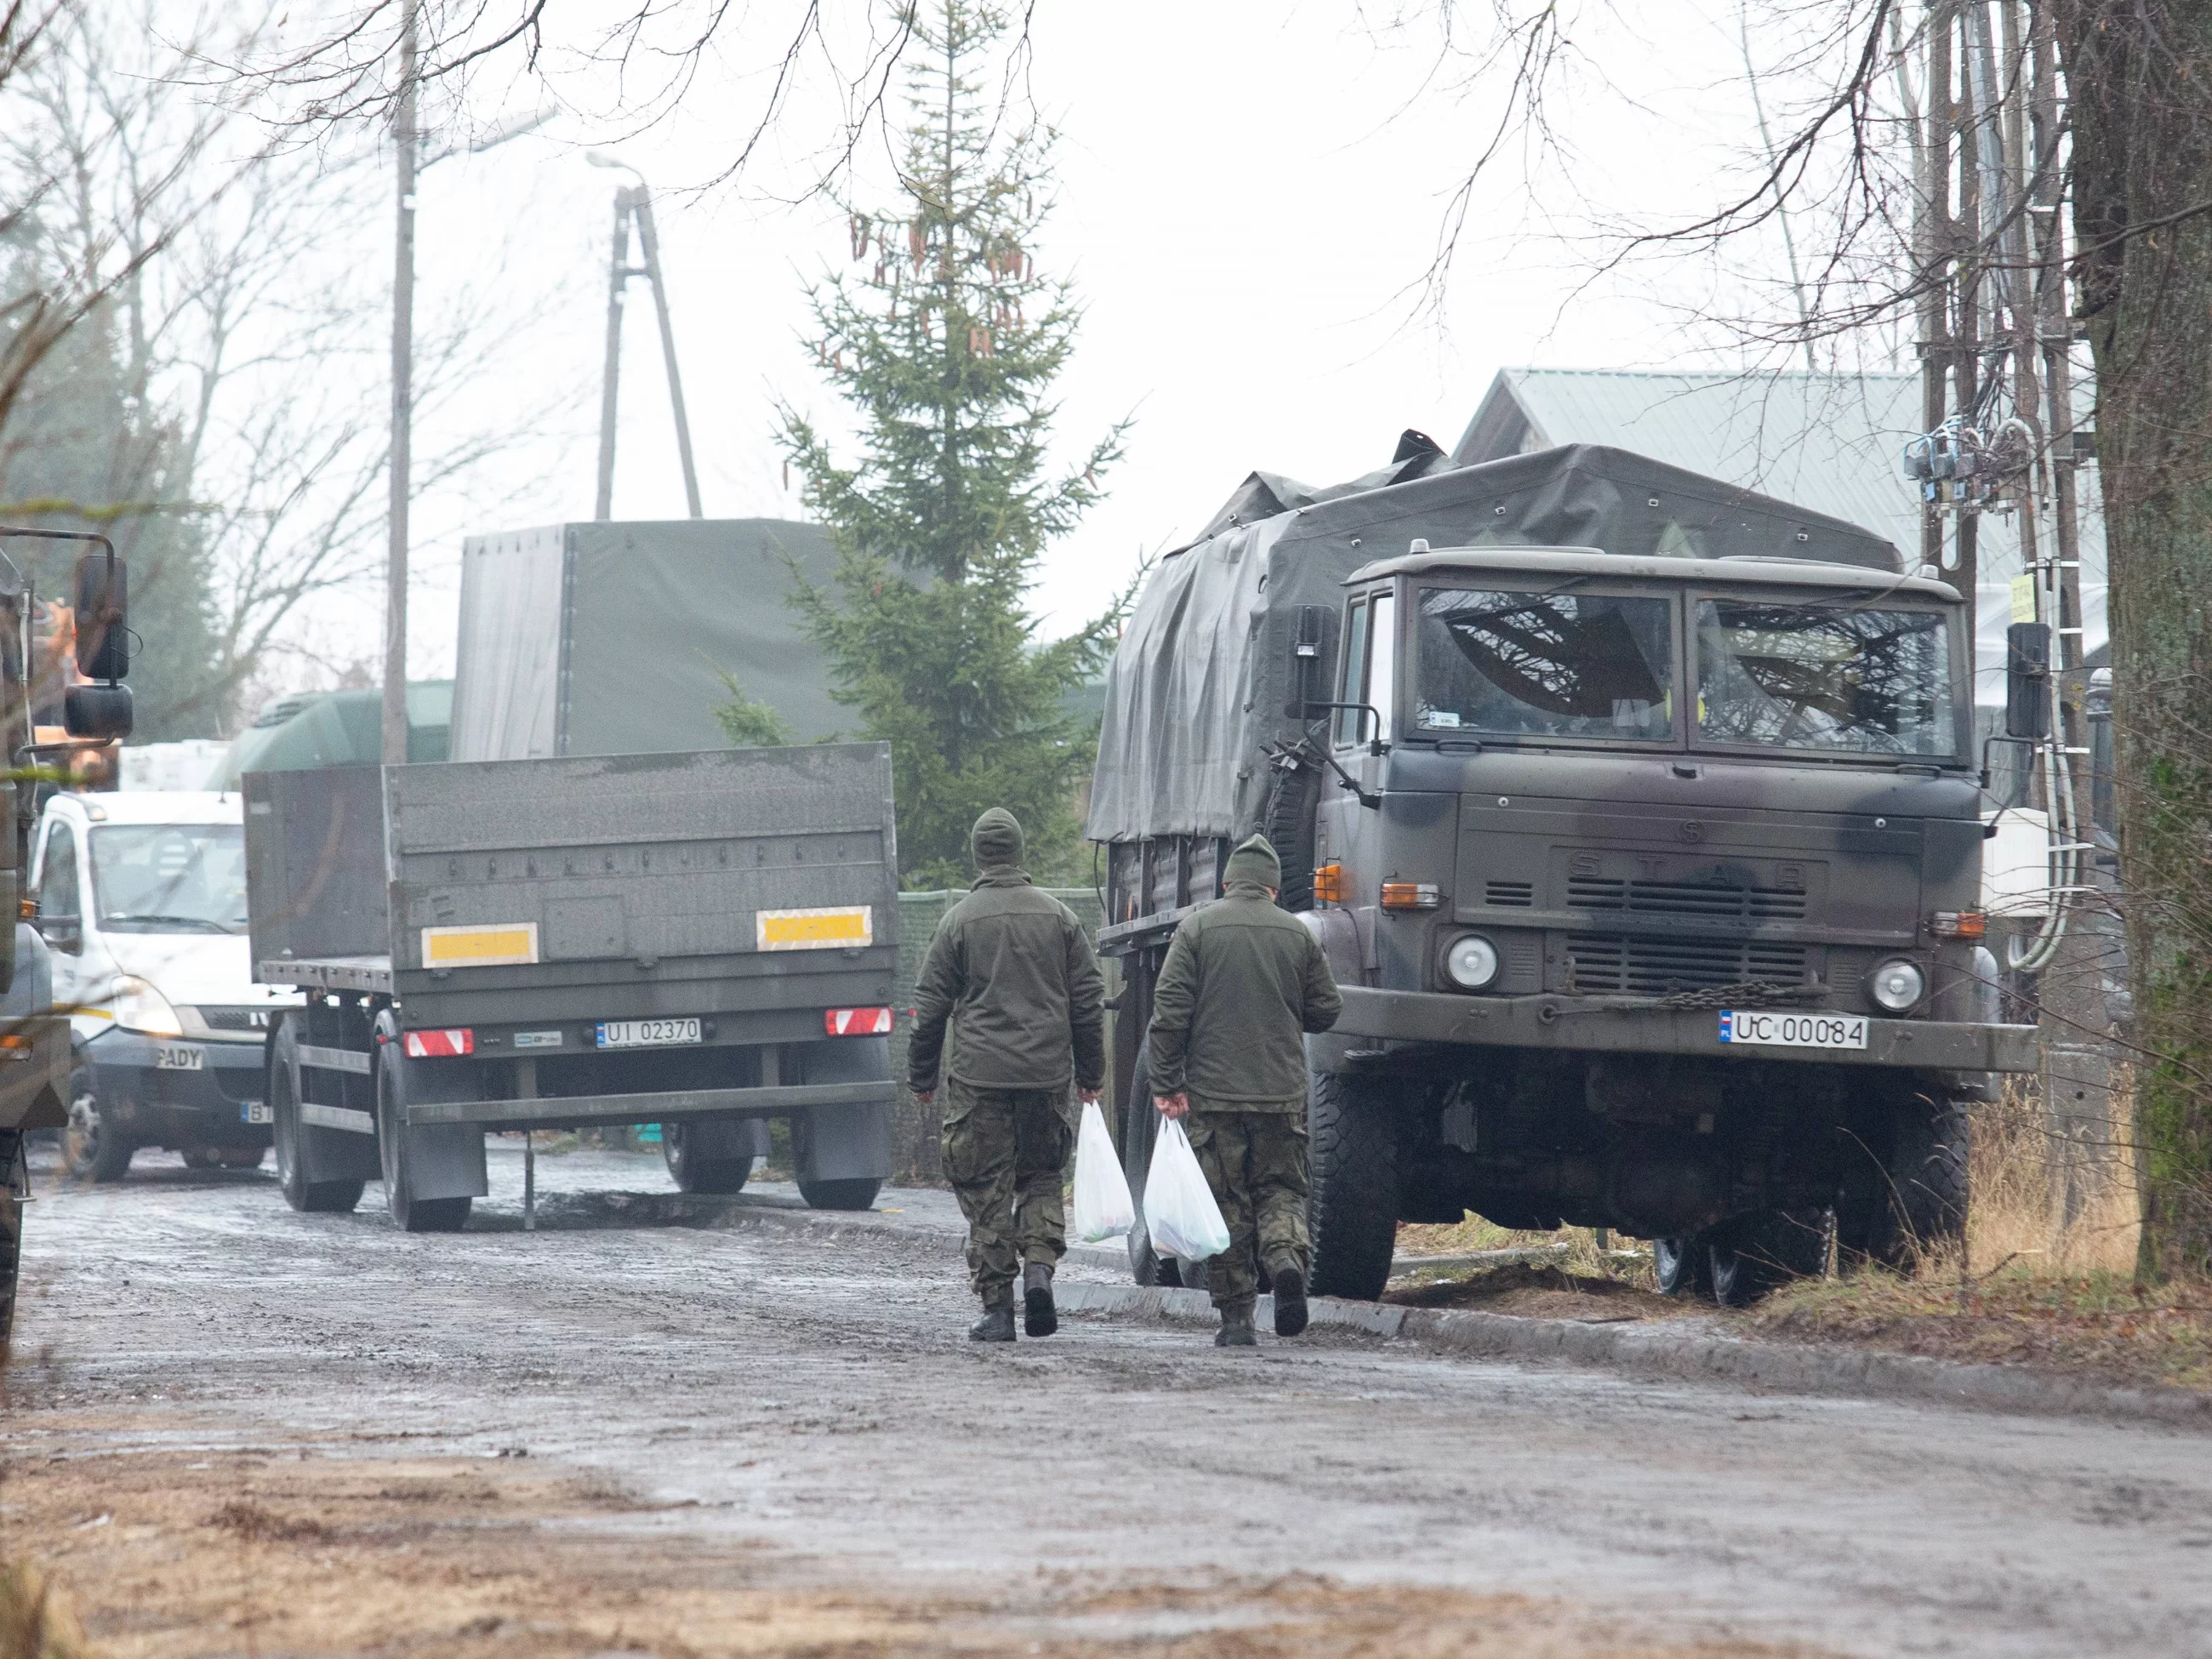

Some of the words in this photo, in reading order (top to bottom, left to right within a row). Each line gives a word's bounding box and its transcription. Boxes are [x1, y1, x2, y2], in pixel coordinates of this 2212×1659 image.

[1570, 852, 1806, 888] STAR
[608, 1023, 630, 1041] UI
[641, 1020, 698, 1040] 02370
[1720, 1029, 1731, 1038] PL
[1736, 1015, 1773, 1040] UC
[1783, 1018, 1862, 1046] 00084
